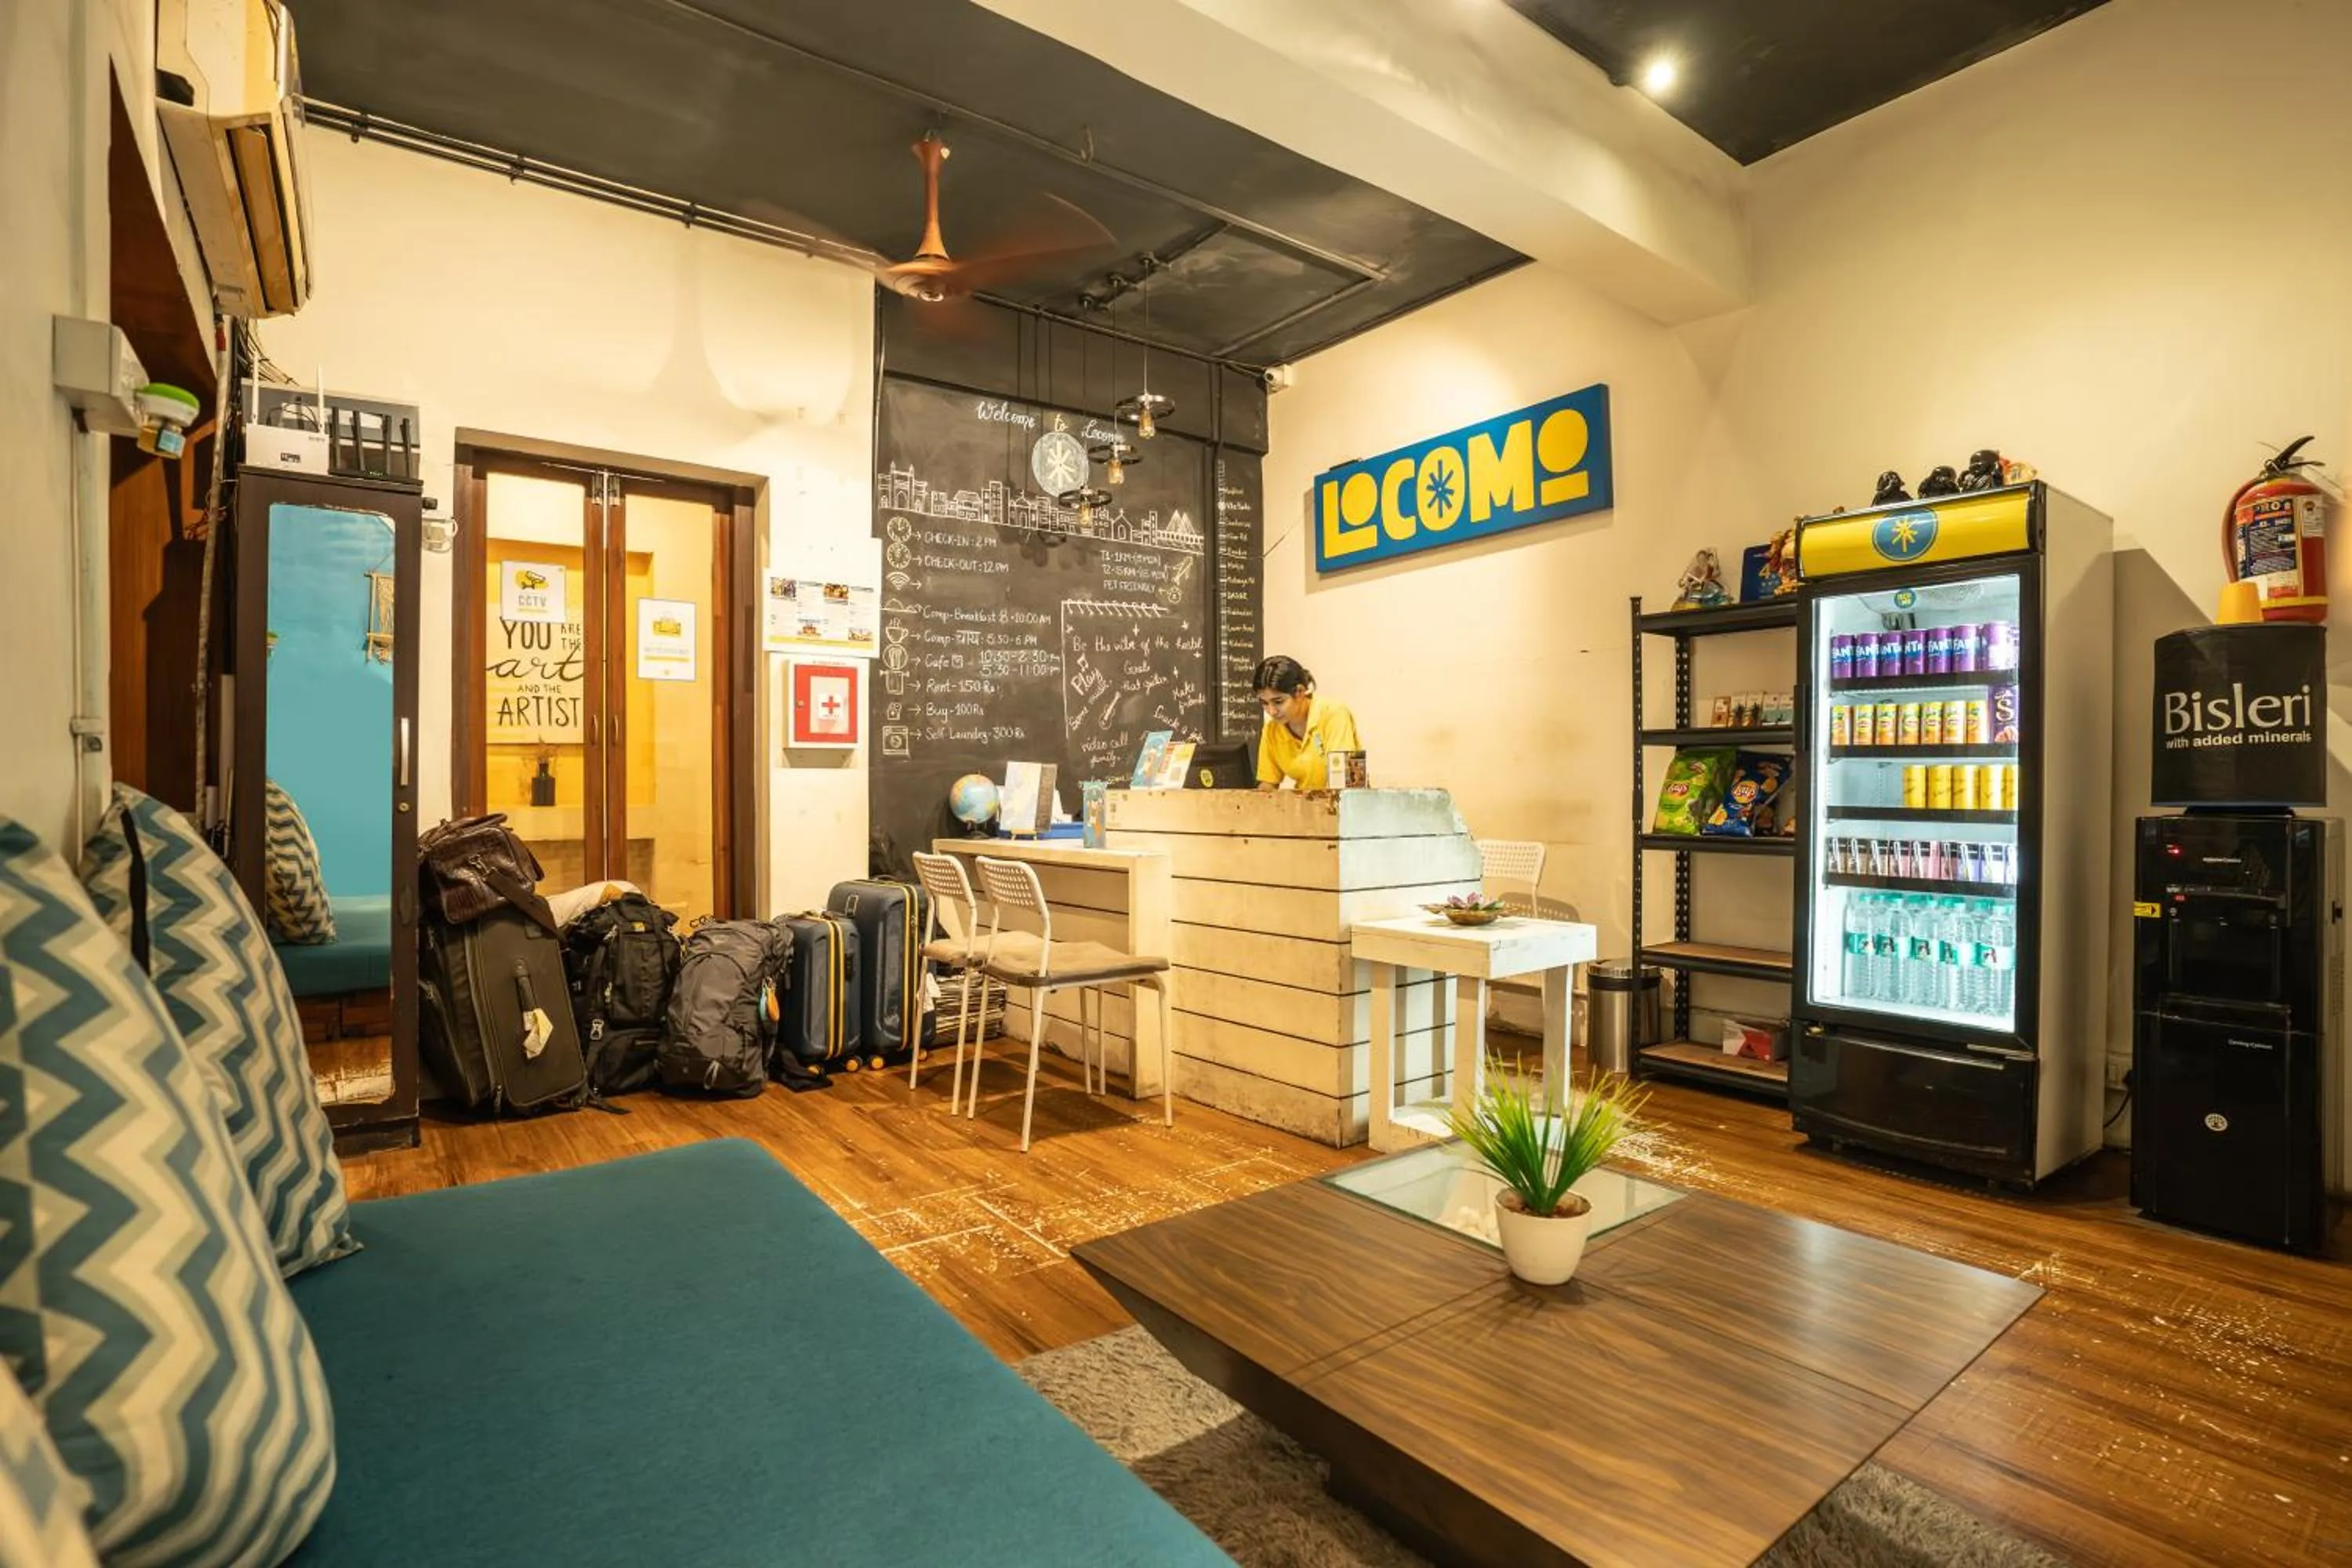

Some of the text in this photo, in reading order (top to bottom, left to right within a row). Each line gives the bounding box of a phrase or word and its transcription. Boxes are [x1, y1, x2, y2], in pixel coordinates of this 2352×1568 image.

[976, 401, 1035, 430] Welcome
[518, 595, 546, 607] CCTV
[499, 616, 581, 650] YOU ARE
[485, 643, 584, 681] art
[517, 684, 562, 694] AND THE
[497, 695, 581, 728] ARTIST
[2165, 683, 2310, 735] Bisleri
[2165, 730, 2312, 750] with added minerals
